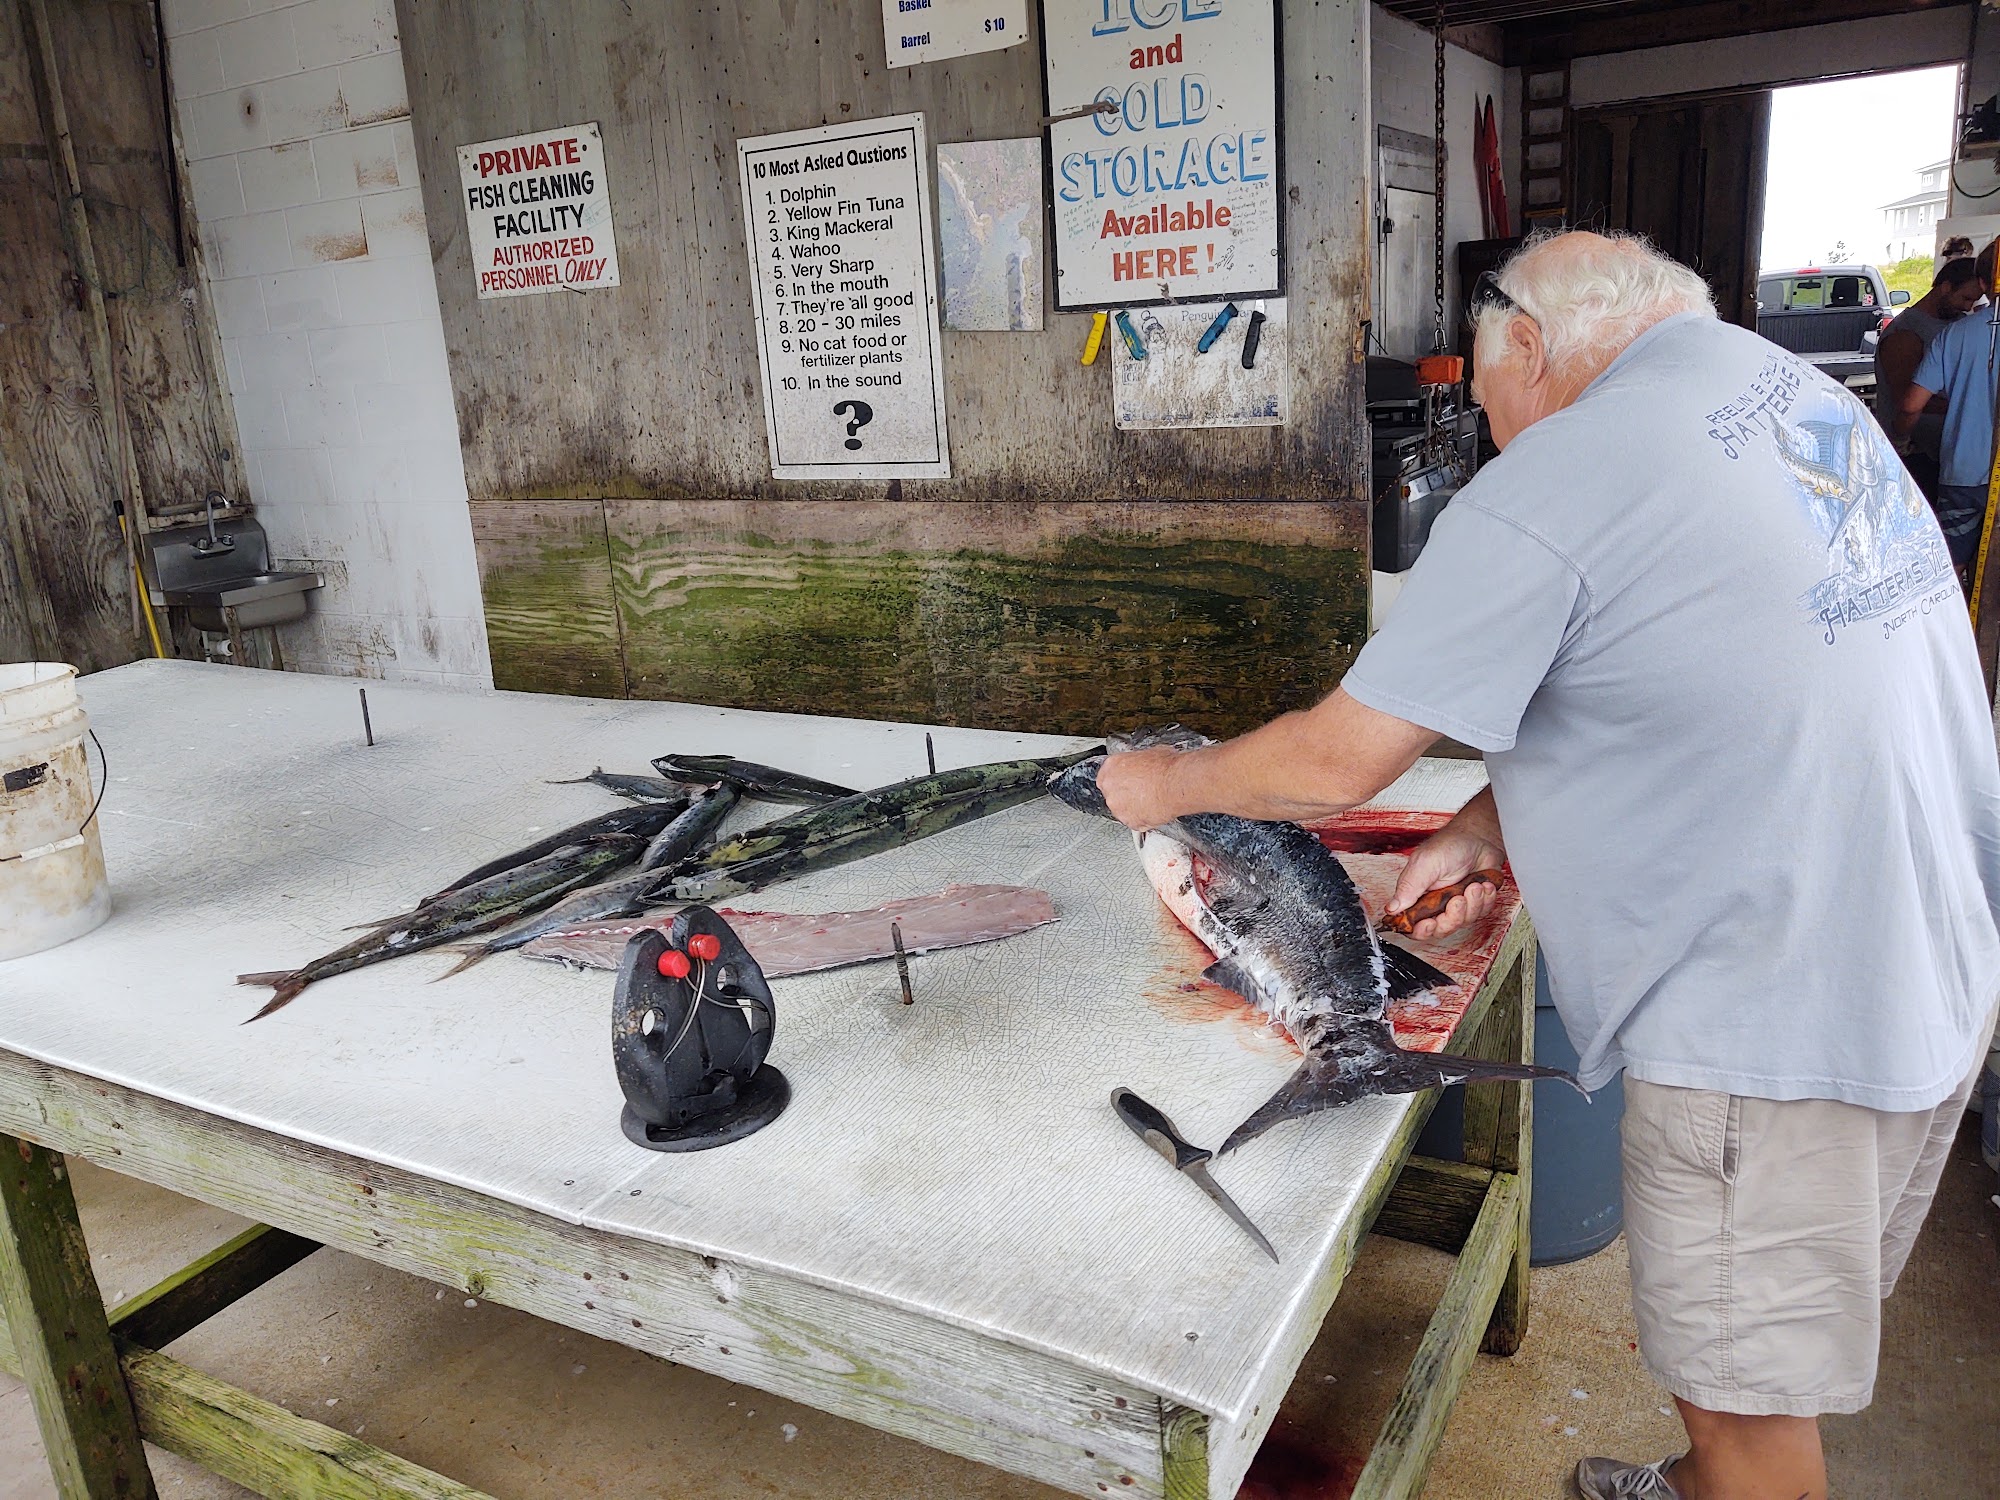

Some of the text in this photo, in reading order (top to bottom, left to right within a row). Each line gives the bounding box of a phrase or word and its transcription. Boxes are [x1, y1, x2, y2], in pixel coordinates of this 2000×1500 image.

[898, 0, 932, 13] Basket
[901, 32, 931, 49] Barrel
[1129, 33, 1183, 70] and
[1092, 73, 1212, 137] COLD
[479, 138, 581, 178] PRIVATE
[753, 145, 907, 179] 10 Most Asked Qustions
[1059, 129, 1270, 202] STORAGE
[468, 171, 594, 211] FISH CLEANING
[765, 184, 836, 205] 1. Dolphin
[494, 203, 585, 238] FACILITY
[767, 196, 904, 224] 2. Yellow Fin Tuna
[1100, 199, 1232, 240] Available
[769, 215, 893, 243] 3. King Mackeral
[493, 236, 594, 266] AUTHORIZED
[771, 243, 841, 261] 4. Wahoo
[481, 258, 607, 291] PERSONNEL ONLY
[773, 259, 874, 280] 5. Very Sharp
[775, 275, 889, 298] 6. In the mouth
[776, 291, 914, 316] 7. They're all good
[779, 320, 793, 334] 8.
[797, 319, 816, 333] 20
[835, 315, 855, 330] 30
[861, 314, 901, 329] miles
[781, 333, 907, 353] 9. No cat food or
[801, 351, 903, 368] fertilizer plants
[781, 371, 902, 391] 10. In the sound
[1708, 366, 1801, 460] HATTERAS
[1819, 541, 1952, 645] HATTERAS VIL
[1882, 607, 1918, 640] NORTH
